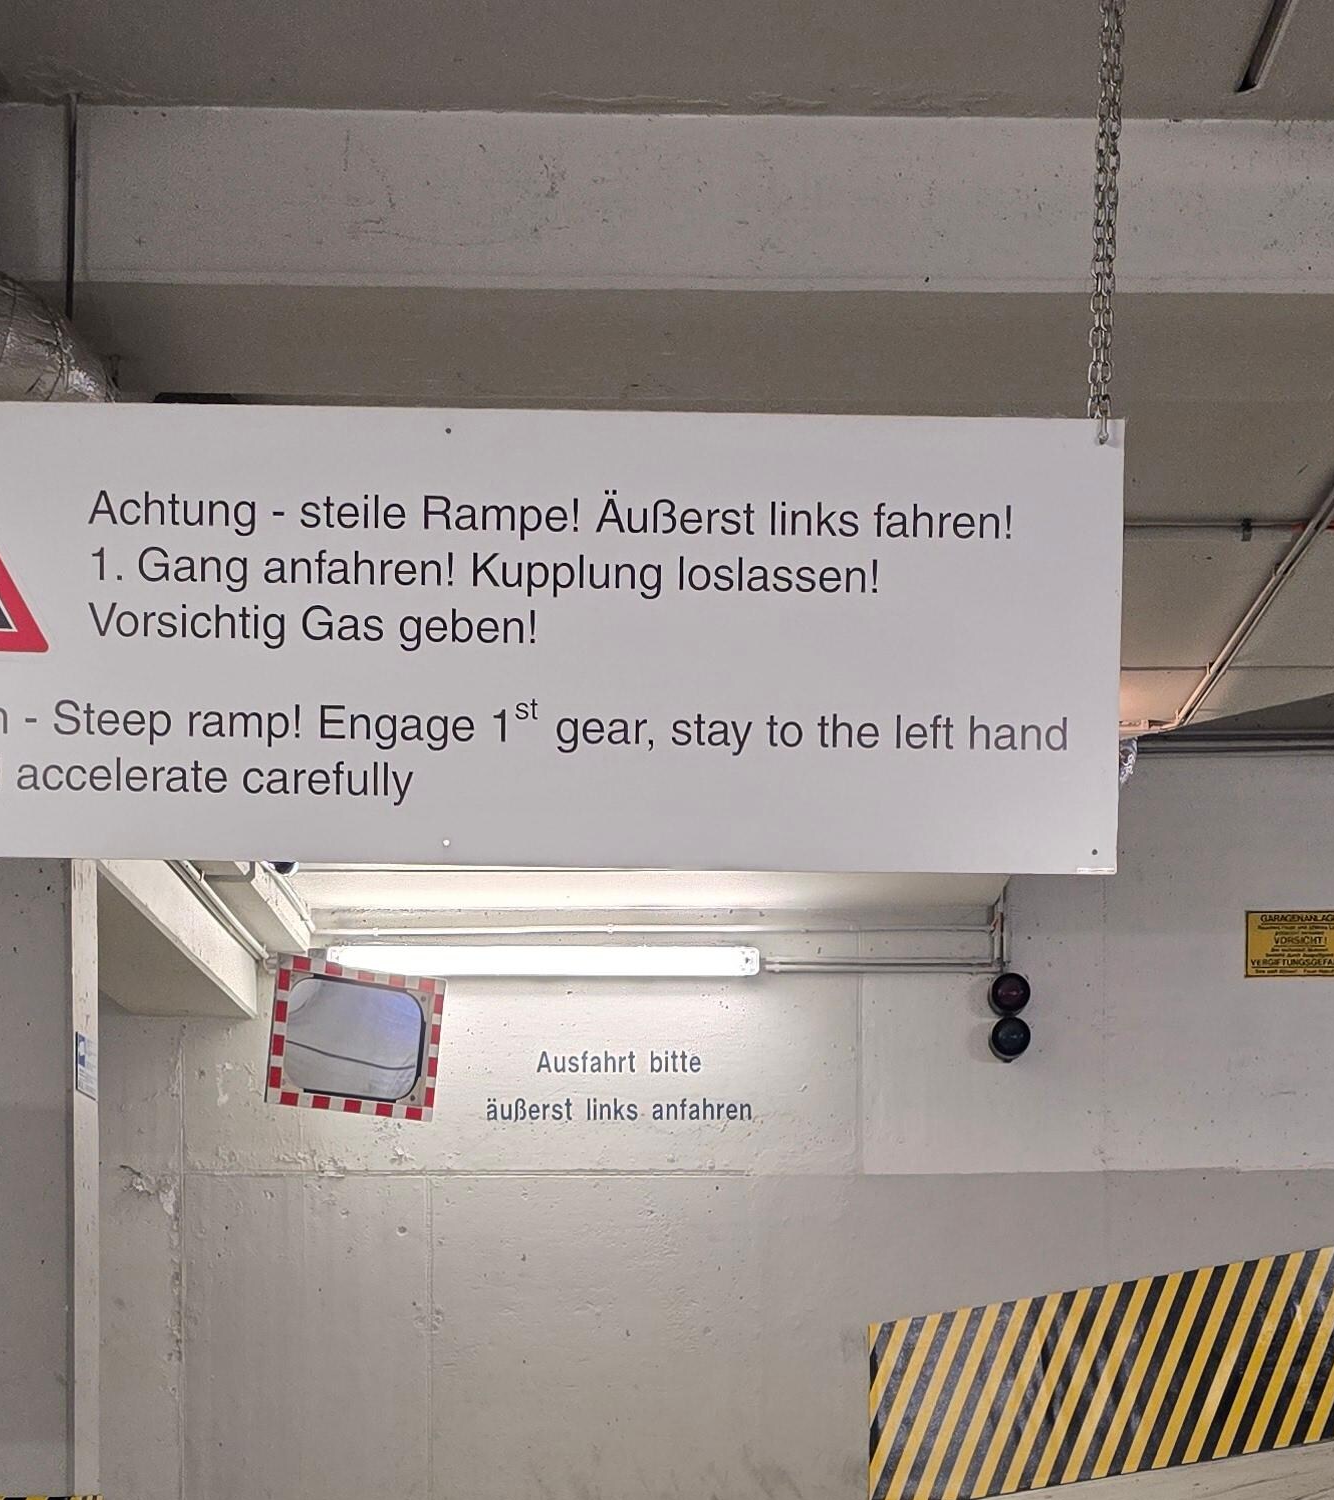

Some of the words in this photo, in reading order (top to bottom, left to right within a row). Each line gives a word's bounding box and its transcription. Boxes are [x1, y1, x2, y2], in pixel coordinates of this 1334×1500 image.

[87, 489, 257, 537] Achtung
[299, 493, 407, 530] steile
[423, 494, 579, 542] Rampe!
[595, 489, 756, 536] Äußerst
[770, 500, 860, 538] links
[873, 501, 1012, 540] fahren!
[91, 546, 123, 581] 1.
[138, 545, 248, 593] Gang
[263, 548, 454, 587] anfahren!
[472, 551, 662, 600] Kupplung
[678, 555, 878, 594] loslassen!
[87, 601, 286, 650] Vorsichtig
[301, 604, 384, 642] Gas
[399, 607, 536, 652] geben!
[53, 699, 172, 746] Steep
[188, 703, 301, 748] ramp!
[319, 704, 475, 752] Engage
[555, 717, 654, 754] gear,
[671, 712, 754, 757] stay
[765, 714, 804, 748] to
[816, 712, 880, 749] the
[895, 713, 954, 750] left
[969, 714, 1068, 752] hand
[16, 756, 228, 795] accelerate
[242, 760, 414, 807] carefully
[1273, 936, 1328, 945] VORSICHT!
[536, 1050, 636, 1074] Ausfahrt
[650, 1049, 702, 1074] bitte
[485, 1097, 573, 1122] äußerst
[585, 1097, 638, 1121] links
[651, 1097, 753, 1121] anfahren
